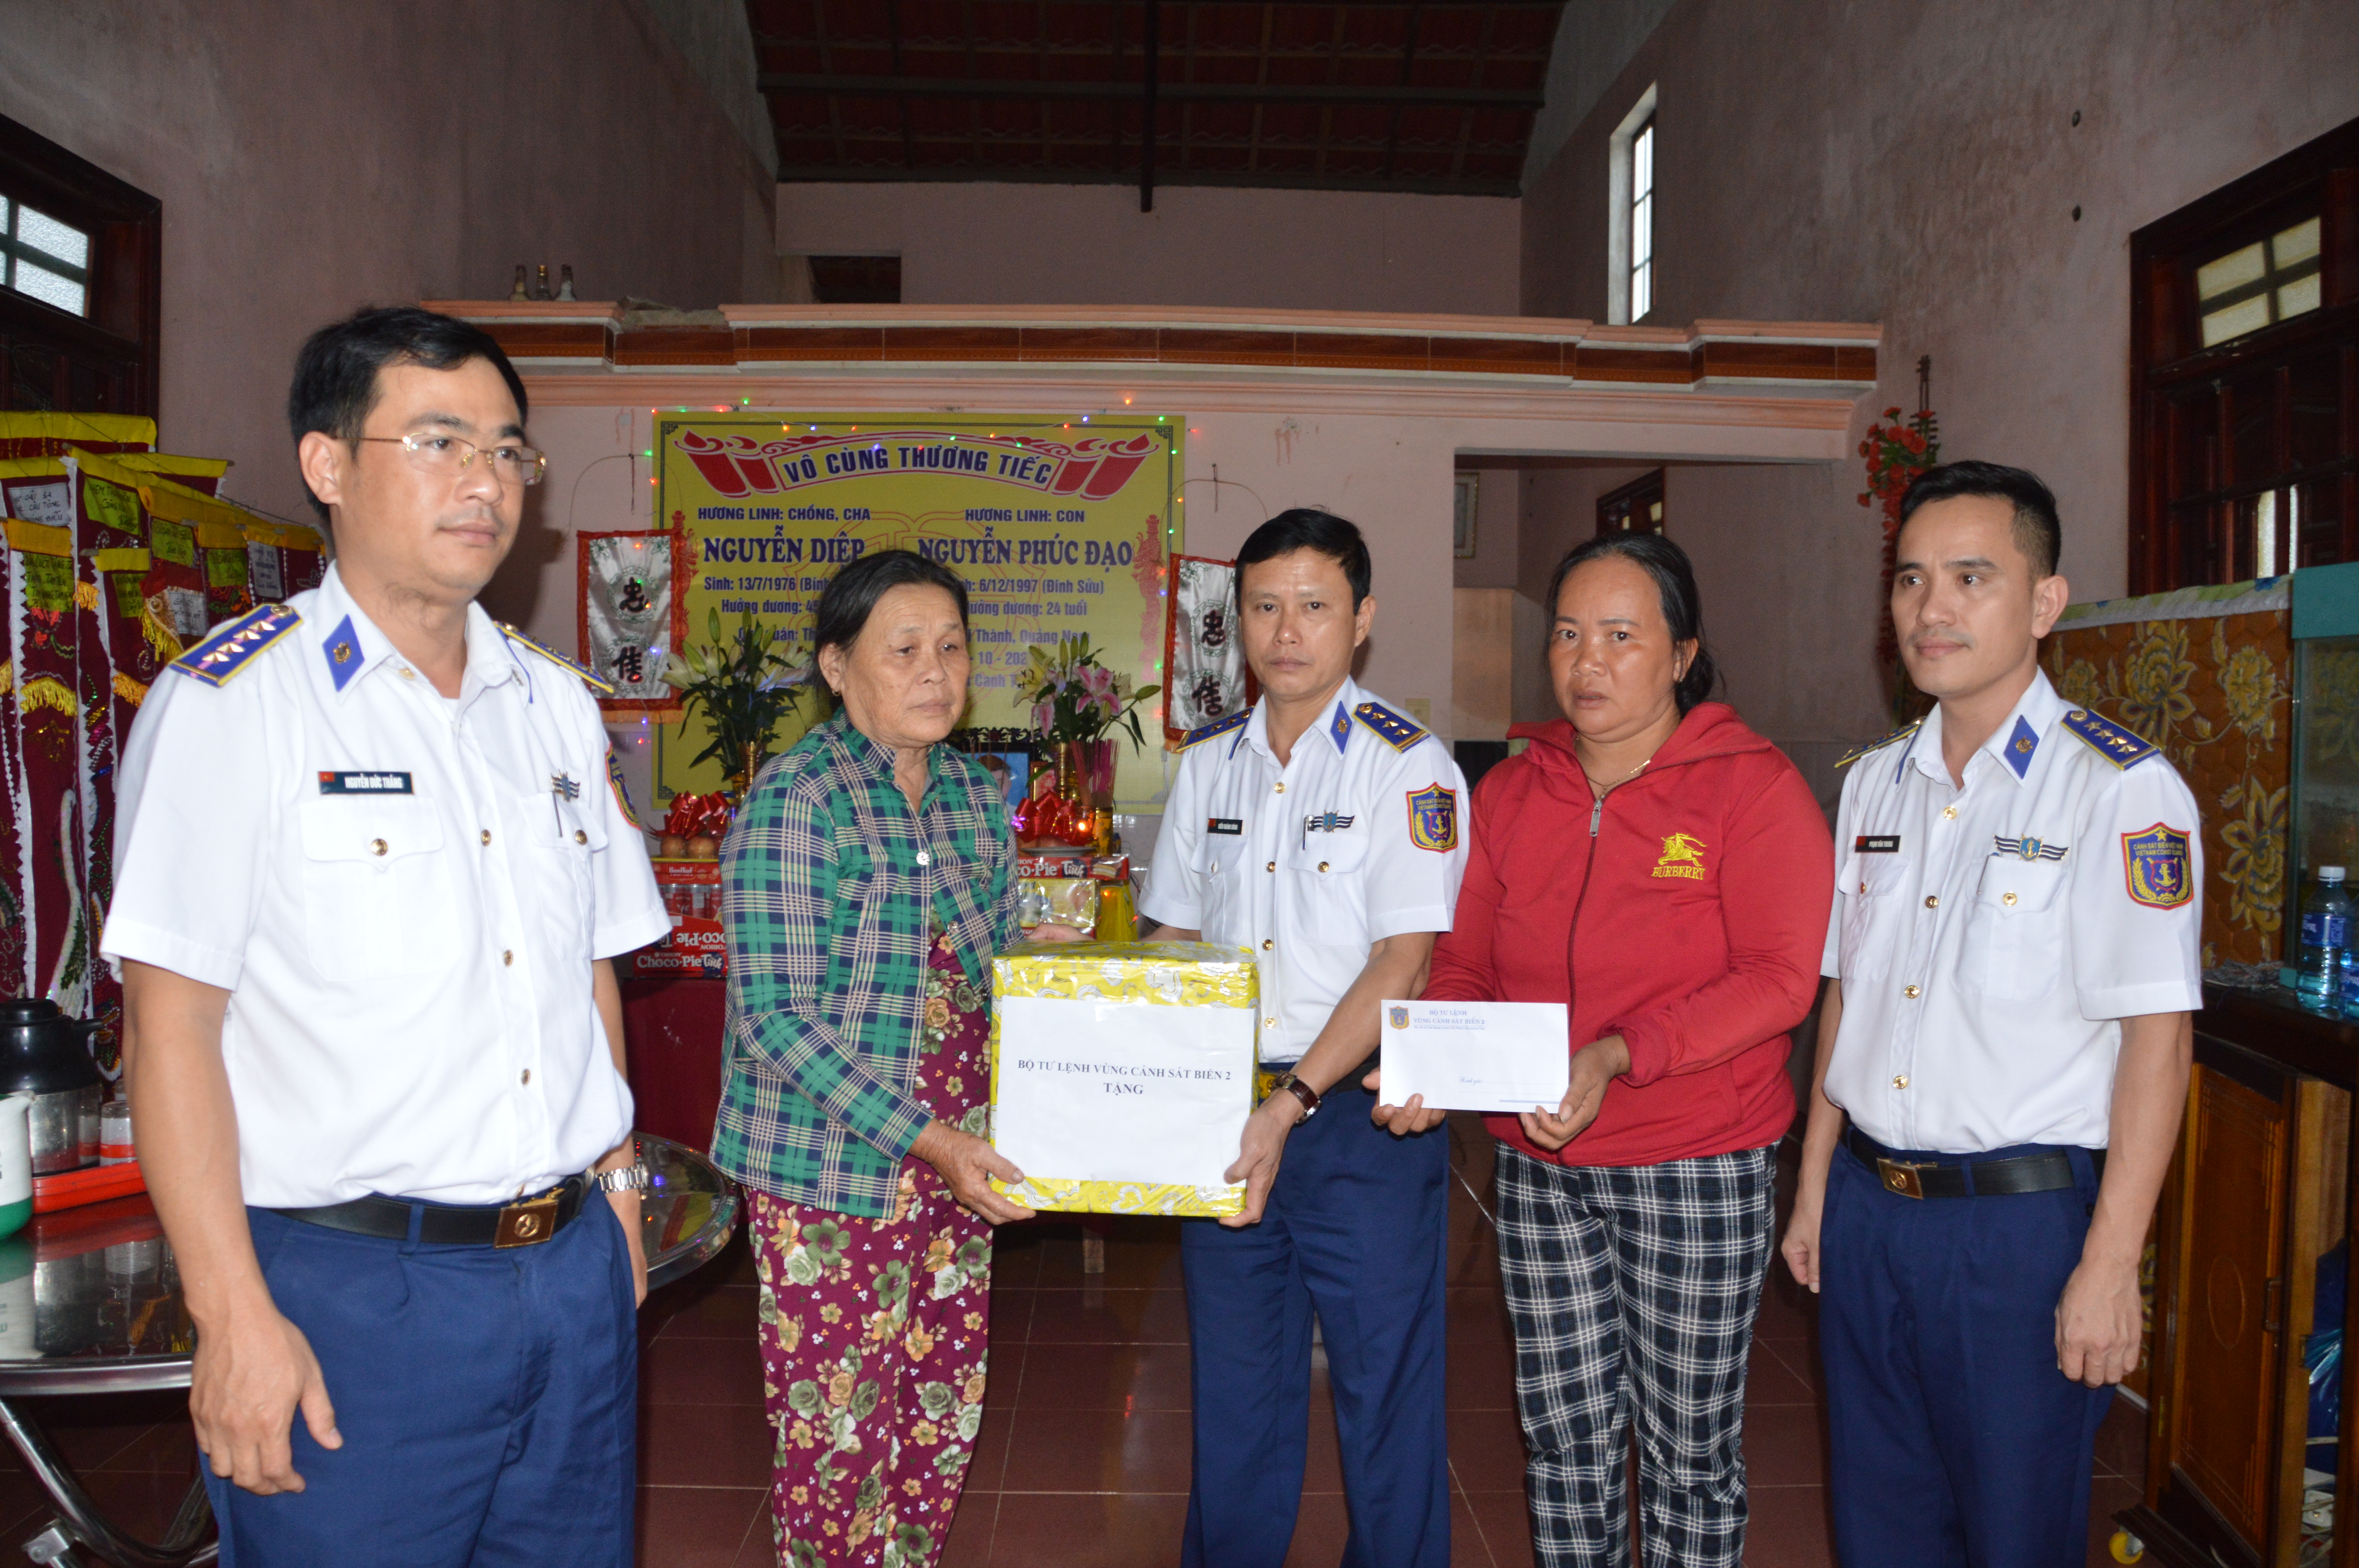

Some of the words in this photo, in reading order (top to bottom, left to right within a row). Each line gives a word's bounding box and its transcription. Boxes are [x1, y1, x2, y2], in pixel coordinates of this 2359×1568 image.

[783, 454, 817, 483] VÔ
[825, 447, 888, 475] CÙNG
[898, 445, 989, 472] THƯƠNG
[998, 454, 1052, 484] TIẾC
[698, 506, 744, 520] HƯƠNG
[749, 508, 783, 520] LINH:
[843, 508, 871, 520] CHA
[965, 507, 1012, 522] HƯƠNG
[1017, 509, 1052, 522] LINH:
[1056, 510, 1085, 522] CON
[703, 525, 803, 563] NGUYỄN
[918, 526, 1012, 565] NGUYỄN
[1018, 533, 1079, 565] PHÚC
[1084, 540, 1132, 573] ĐẠO
[704, 577, 734, 591] Sinh:
[738, 577, 796, 591] 13/7/1976
[979, 579, 1038, 593] 6/12/1997
[1042, 579, 1073, 594] (Đinh
[1077, 577, 1104, 595] Sửu)
[721, 597, 758, 614] Hưởng
[762, 599, 802, 614] dương:
[1003, 601, 1043, 616] dương:
[1046, 602, 1061, 615] 24
[1065, 599, 1087, 616] tuổi
[976, 628, 1015, 644] Thành,
[1020, 628, 1058, 645] Quảng
[1005, 652, 1027, 665] 202
[975, 673, 1006, 687] Canh
[1651, 866, 1705, 880] BURBERRY
[1018, 1060, 1034, 1071] BỘ
[1037, 1060, 1056, 1071] TƯ
[1058, 1062, 1090, 1074] LỆNH
[1094, 1062, 1128, 1076] VÙNG
[1130, 1064, 1165, 1078] CẢNH
[1168, 1067, 1191, 1079] SÁT
[1194, 1068, 1223, 1080] BIỂN
[1225, 1071, 1231, 1080] 2
[1103, 1082, 1144, 1096] TẶNG
